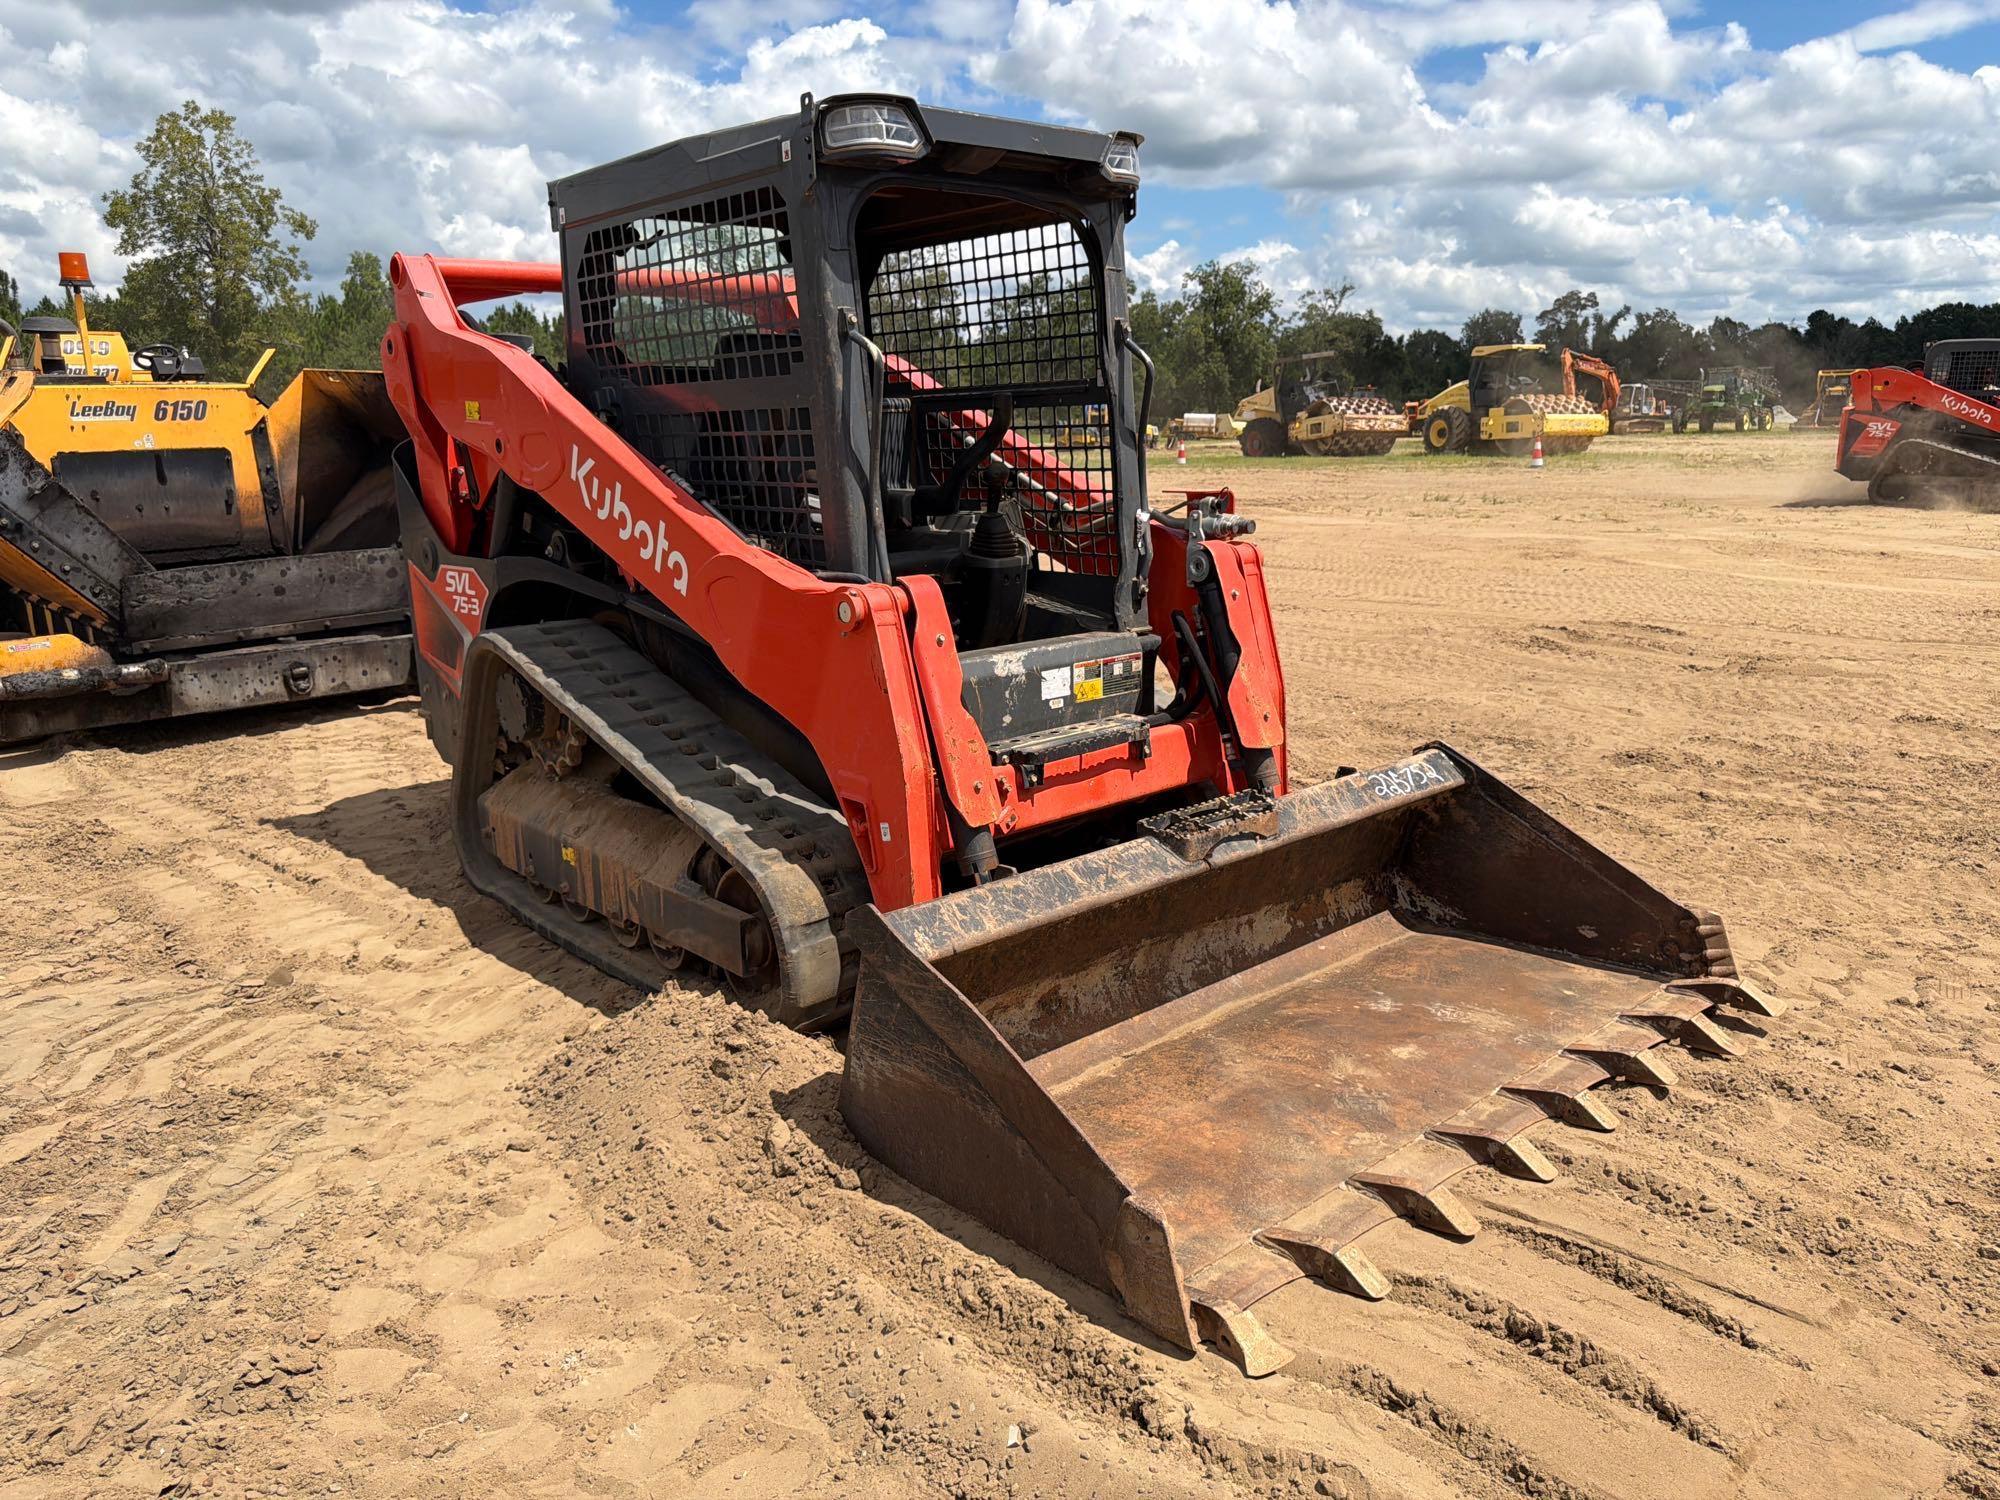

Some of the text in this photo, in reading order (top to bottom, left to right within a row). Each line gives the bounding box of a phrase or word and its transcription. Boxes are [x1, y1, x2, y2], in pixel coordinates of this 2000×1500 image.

[70, 400, 207, 421] LeeBoy 6150
[1941, 394, 1991, 423] Kubota
[1866, 422, 1896, 430] SVL
[571, 444, 688, 597] Kubota
[445, 571, 476, 595] SVL
[452, 595, 479, 616] 75-3
